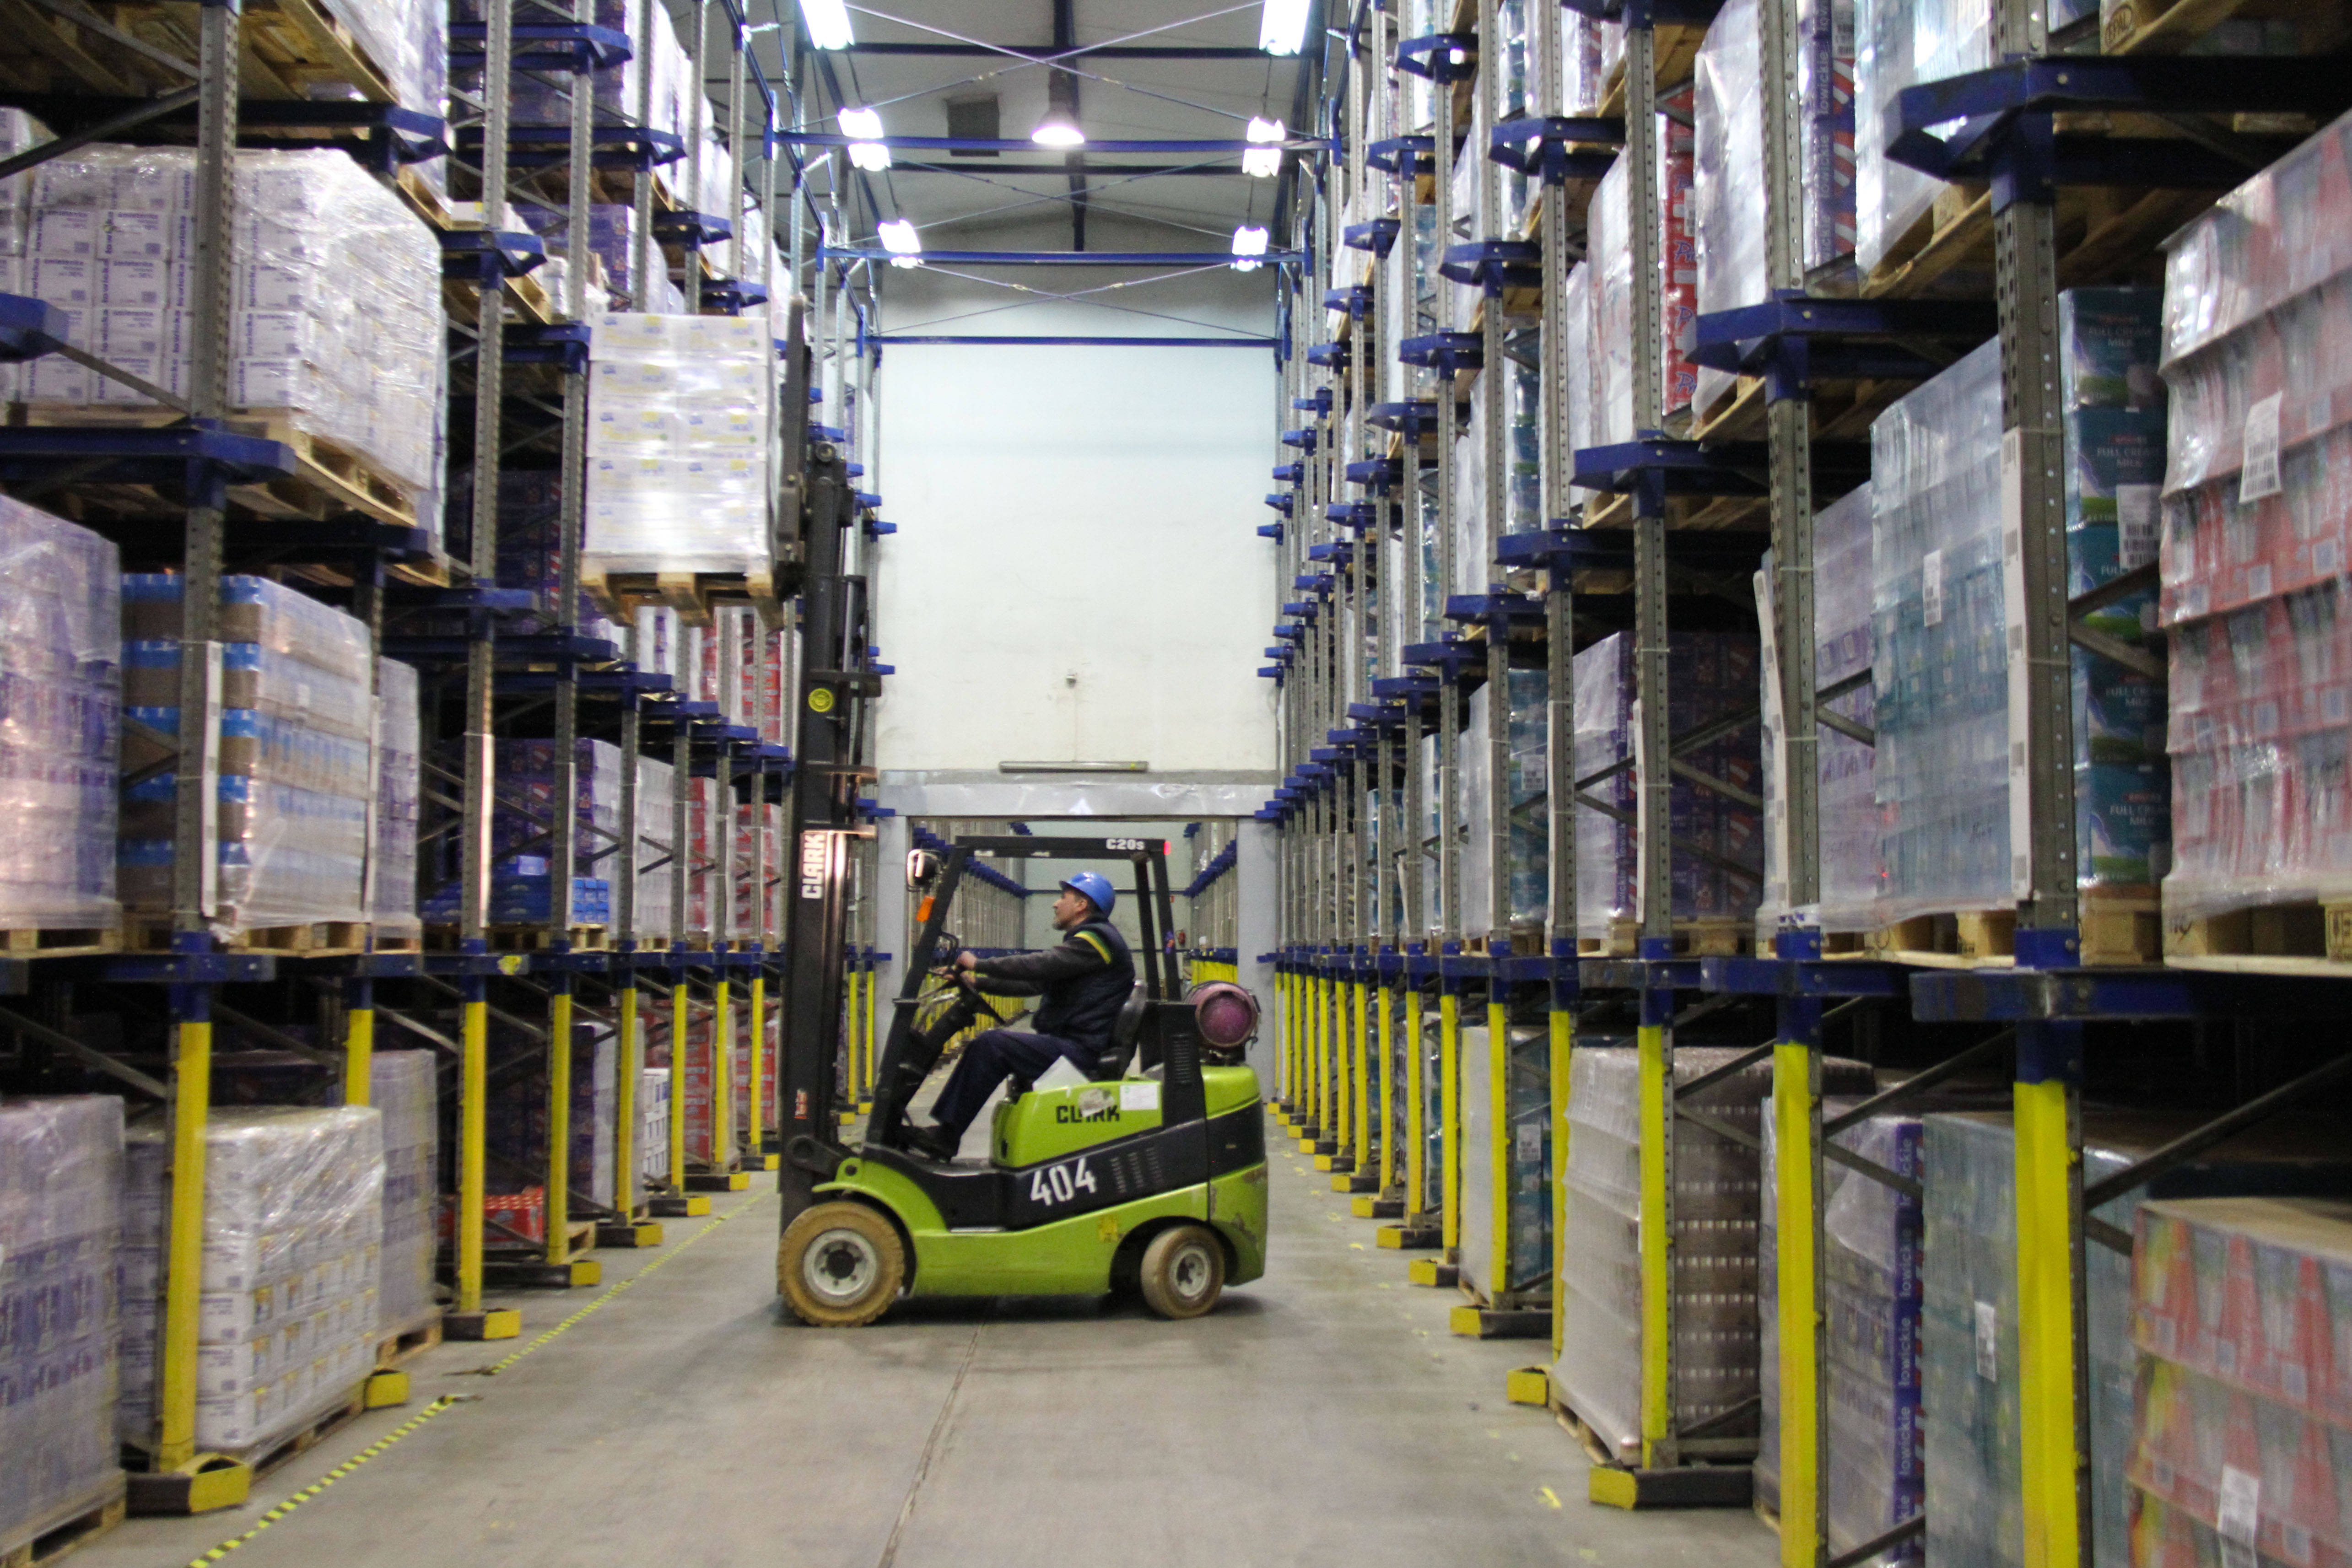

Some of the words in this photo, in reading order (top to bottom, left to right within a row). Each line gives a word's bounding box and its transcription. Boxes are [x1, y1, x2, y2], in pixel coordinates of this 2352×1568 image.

[802, 834, 825, 899] CLARK
[1106, 838, 1144, 850] C20s
[1030, 1157, 1098, 1207] 404
